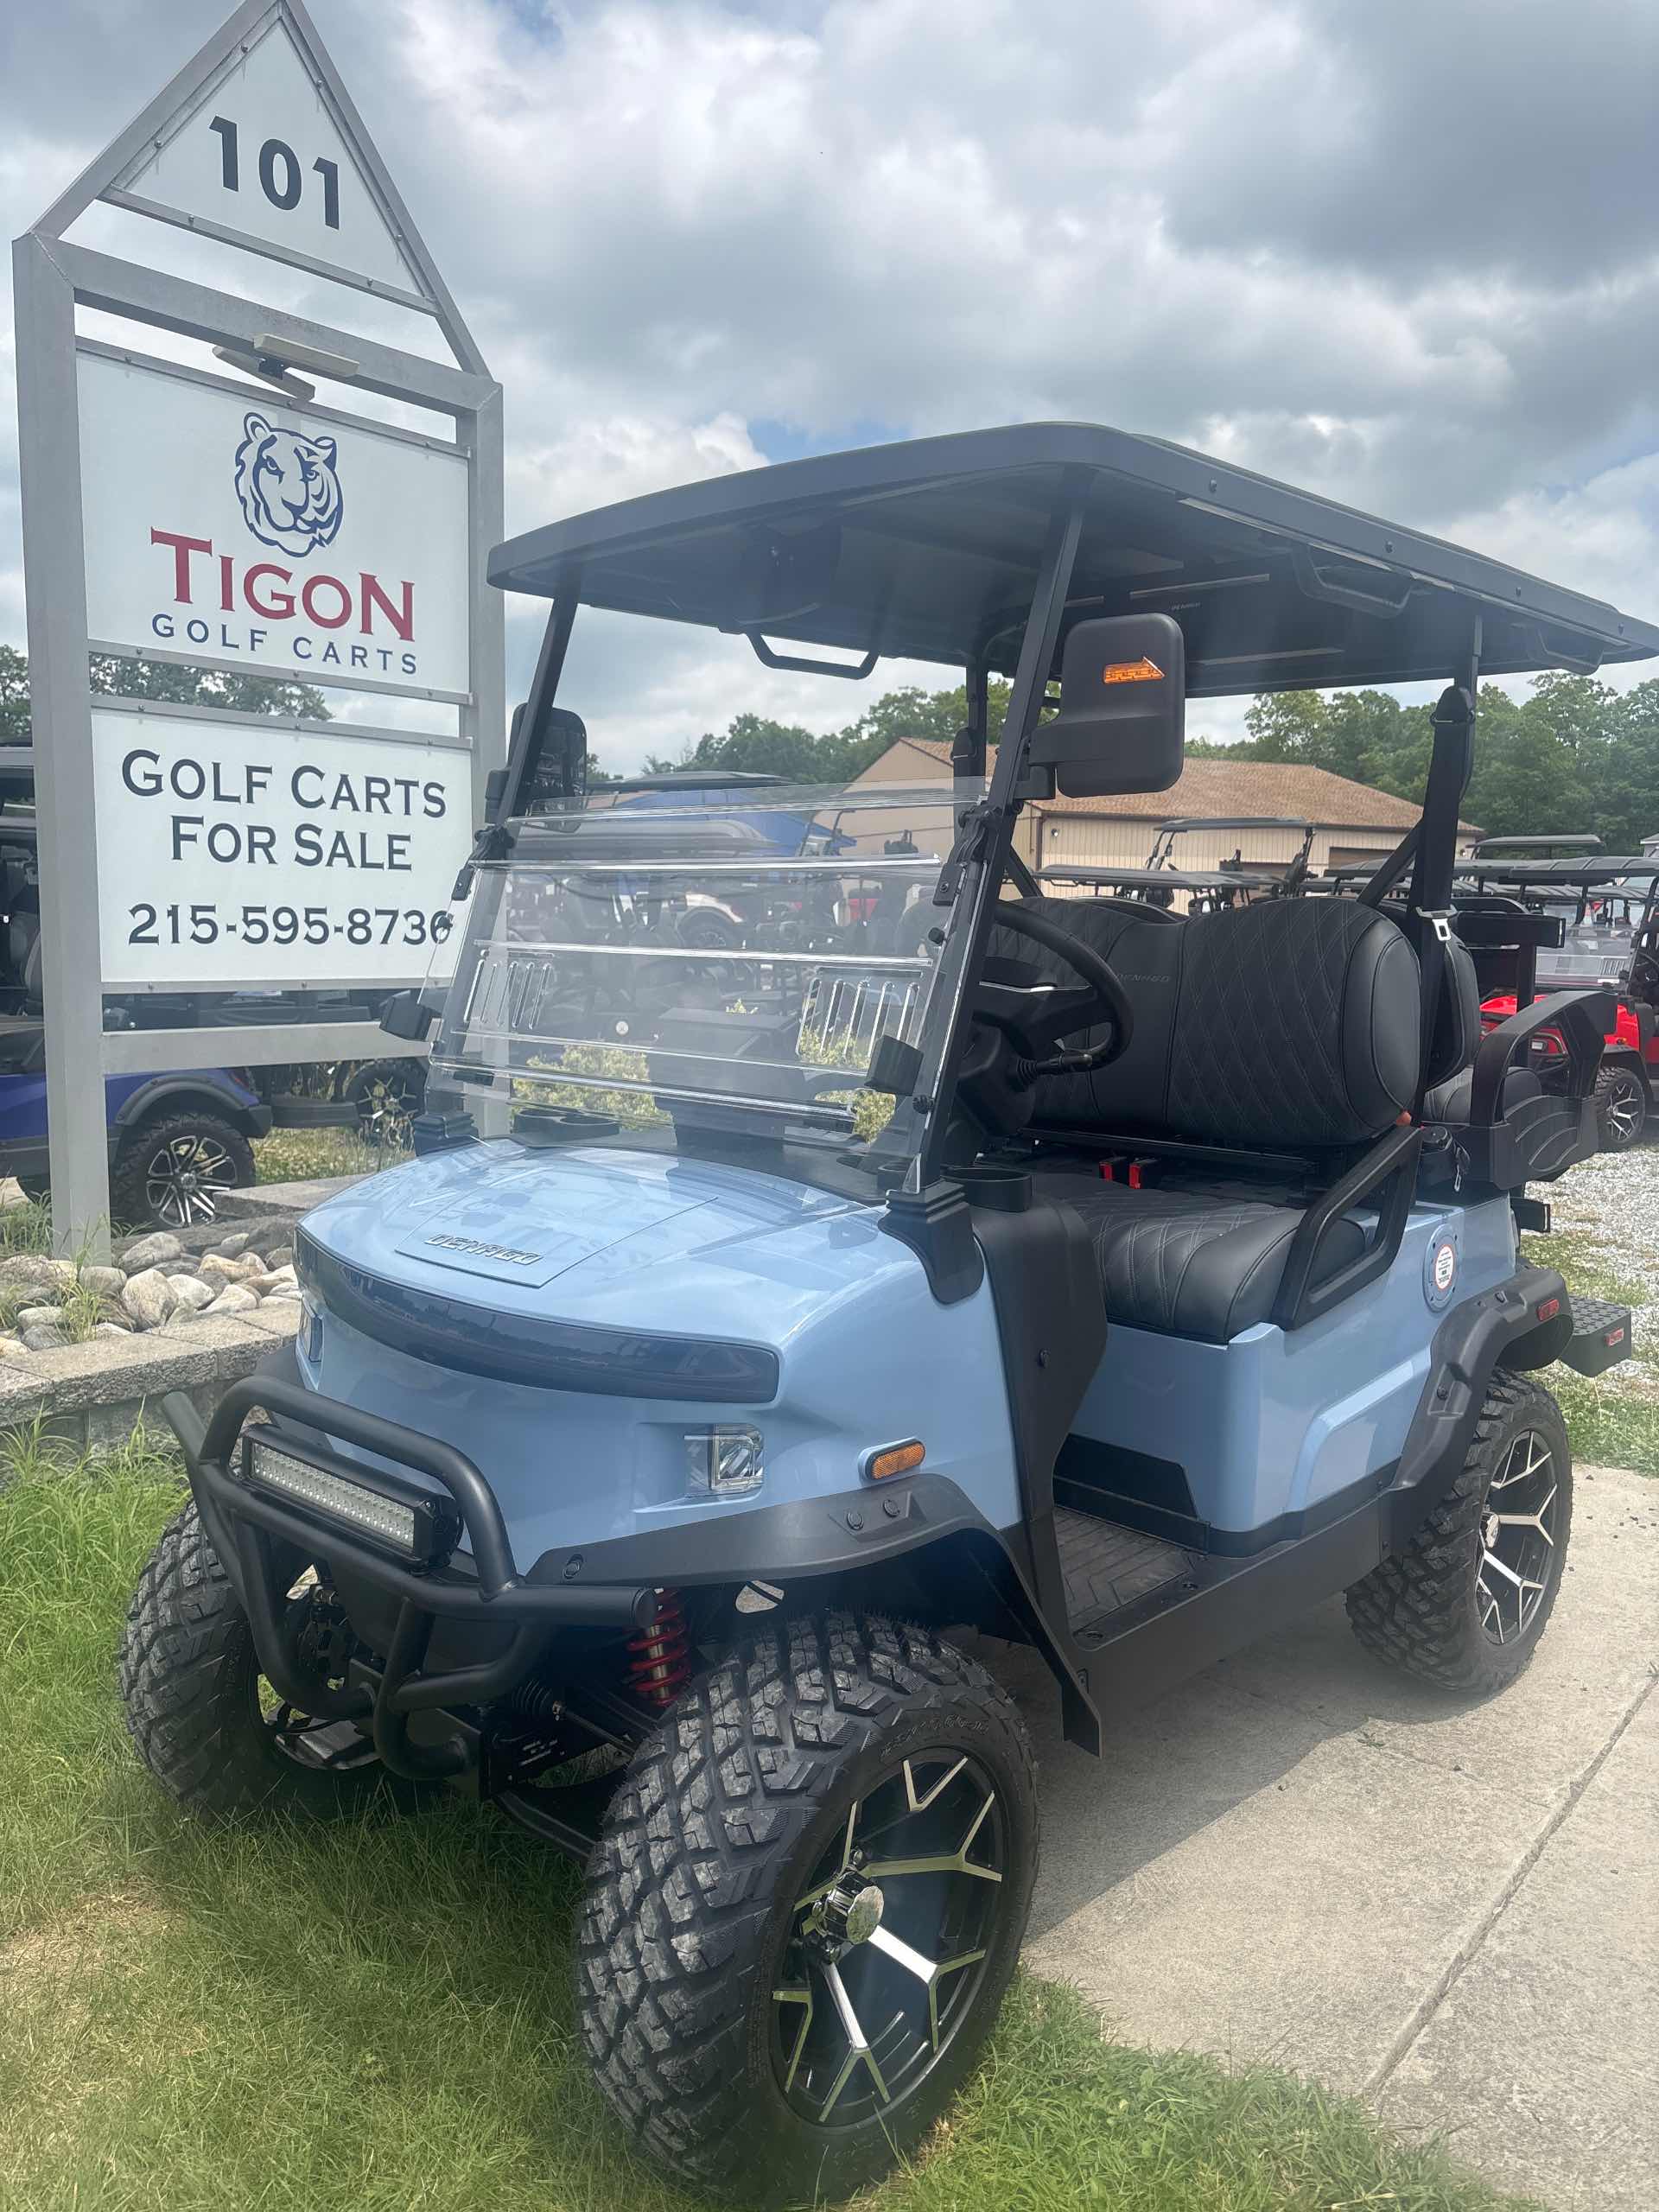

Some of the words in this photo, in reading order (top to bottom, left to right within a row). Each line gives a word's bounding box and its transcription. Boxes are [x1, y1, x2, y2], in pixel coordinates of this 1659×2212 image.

[209, 116, 340, 231] 101
[150, 526, 416, 643] TIGON
[151, 613, 269, 652] GOLF
[293, 636, 417, 675] CARTS
[121, 748, 274, 805] GOLF
[290, 765, 448, 819] CARTS
[170, 815, 278, 865] FOR
[294, 823, 413, 872] SALE
[424, 1234, 544, 1265] DENAGO
